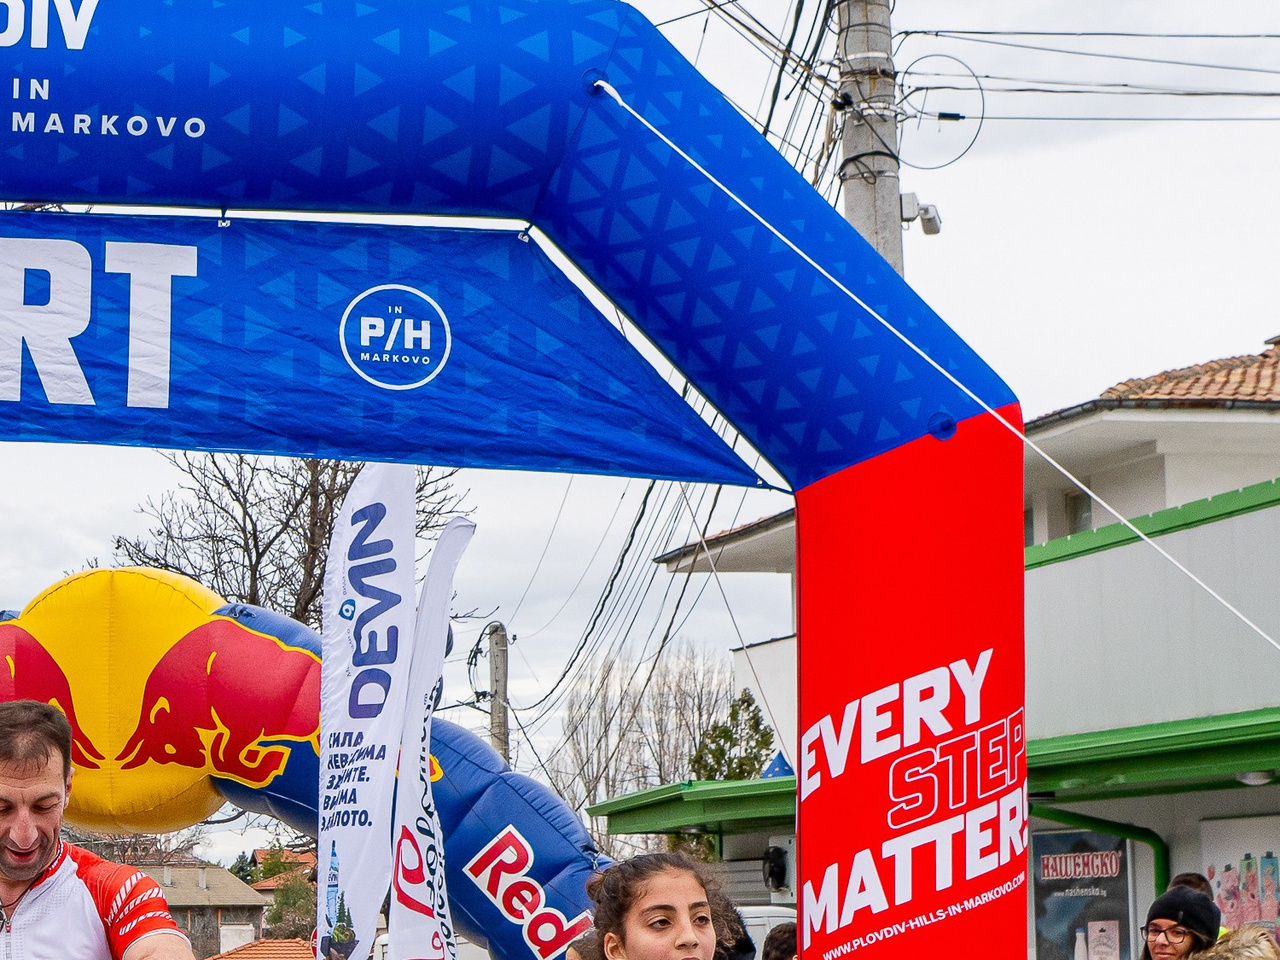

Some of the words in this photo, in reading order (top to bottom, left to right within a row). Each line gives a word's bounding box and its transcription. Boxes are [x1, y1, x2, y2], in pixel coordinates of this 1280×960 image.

[13, 78, 49, 100] IN
[12, 111, 206, 138] MARKOVO
[360, 316, 431, 351] P/H
[360, 353, 430, 364] MARKOVO
[348, 502, 402, 718] DEVIN
[801, 648, 994, 802] EVERY
[887, 706, 1025, 829] STEP
[1041, 851, 1120, 880] НАШЕНСКО
[467, 830, 593, 960] Red
